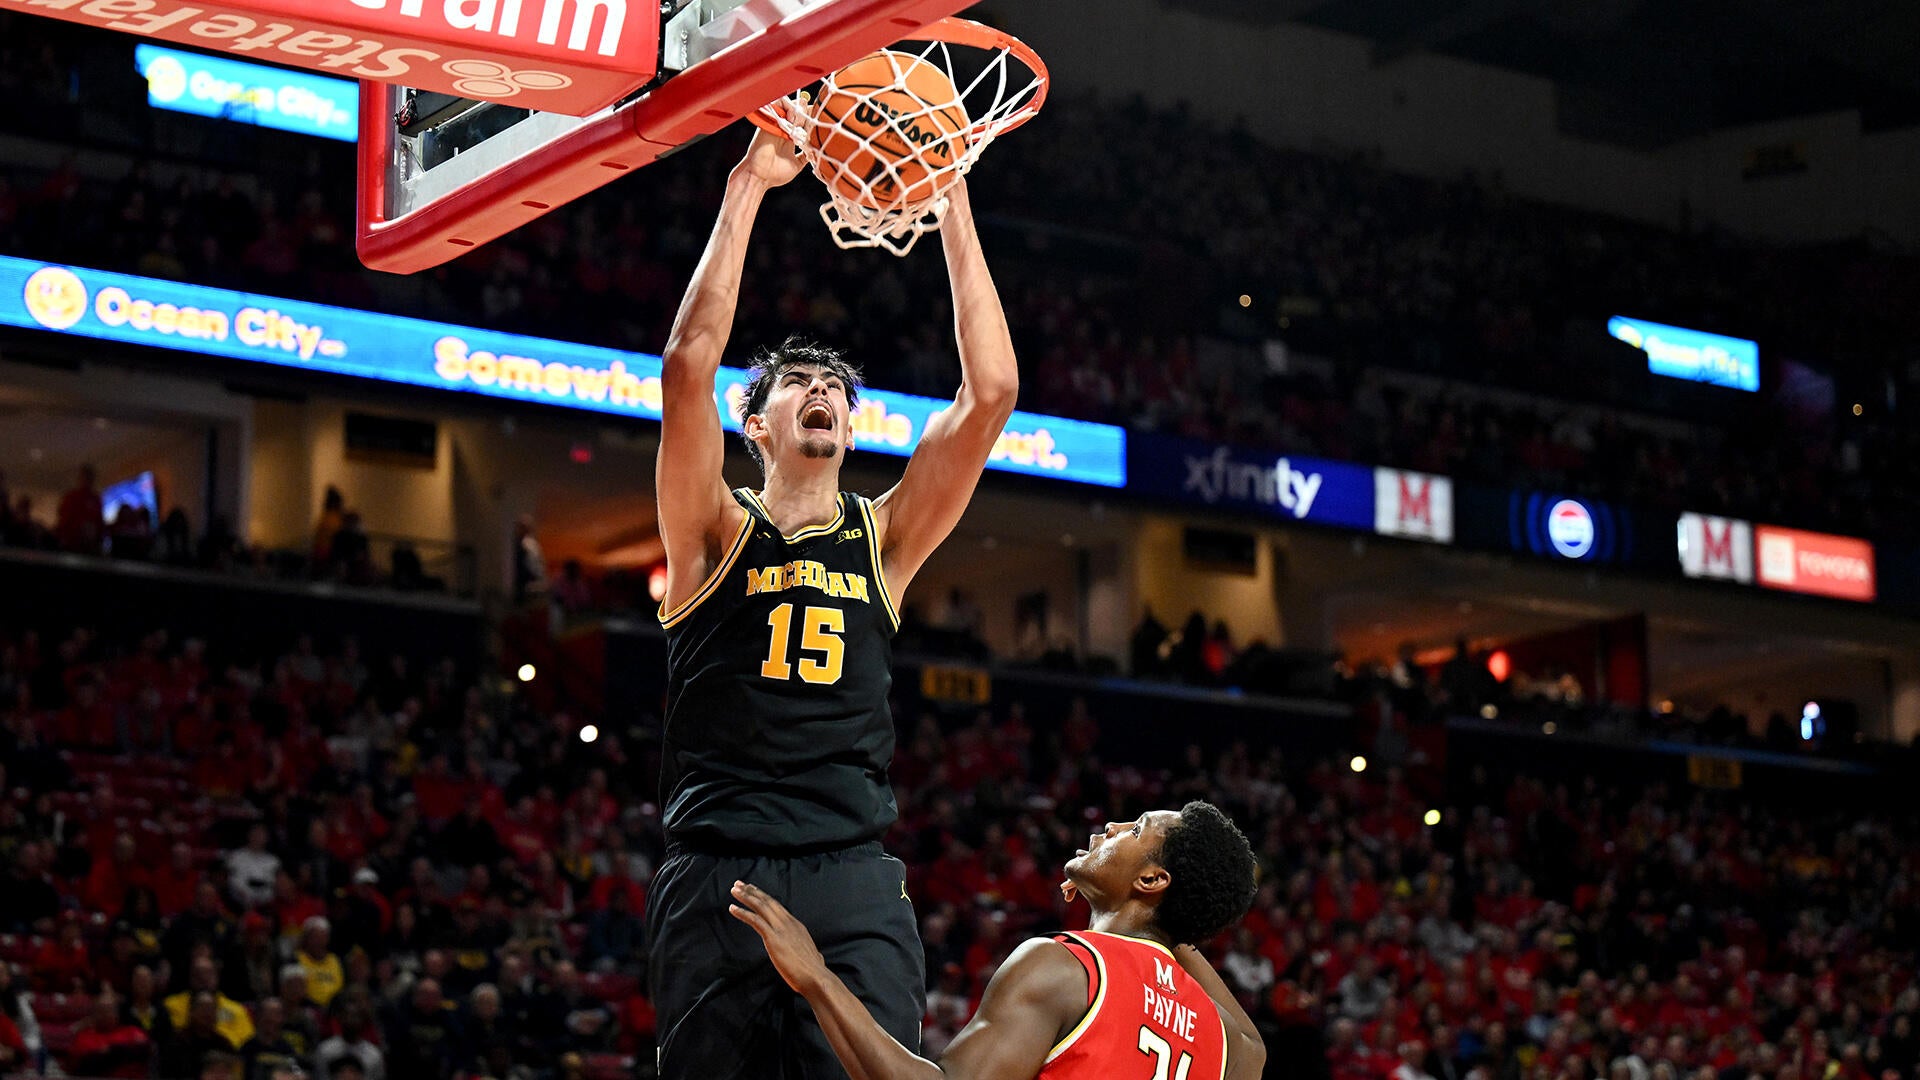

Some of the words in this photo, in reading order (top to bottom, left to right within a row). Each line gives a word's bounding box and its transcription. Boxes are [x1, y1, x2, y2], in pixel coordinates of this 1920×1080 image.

[189, 14, 441, 77] State
[855, 98, 950, 158] Wilson
[95, 287, 229, 341] Ocean
[234, 307, 322, 360] City
[1183, 446, 1322, 518] xfinity
[1397, 473, 1431, 526] M
[1702, 517, 1735, 571] M
[761, 603, 846, 685] 15
[1153, 956, 1177, 992] M
[1143, 983, 1198, 1043] PAYNE
